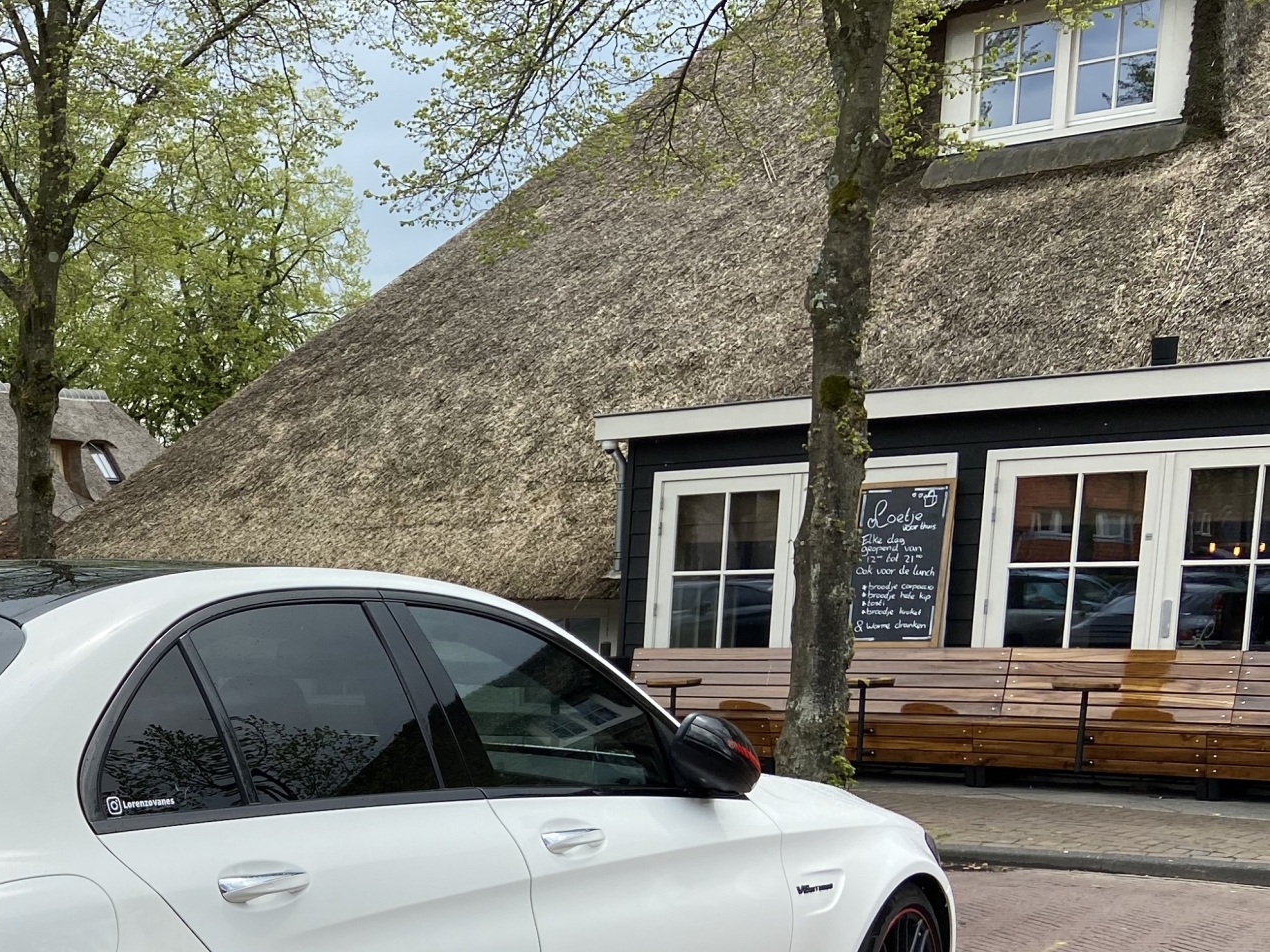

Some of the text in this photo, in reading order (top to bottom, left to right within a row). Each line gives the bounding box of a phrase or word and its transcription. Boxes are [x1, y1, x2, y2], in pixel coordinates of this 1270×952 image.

[867, 499, 923, 529] Loetje
[920, 522, 937, 530] thuis
[861, 533, 906, 546] Elke dag
[886, 552, 899, 563] tot
[856, 564, 873, 575] Ook
[899, 564, 910, 575] de
[912, 564, 935, 577] lunch
[868, 581, 898, 592] broodje
[867, 590, 896, 602] broodje
[919, 591, 931, 603] kip
[867, 599, 885, 607] tosti
[866, 606, 894, 617] broodje
[854, 620, 863, 632] &
[122, 798, 175, 809] Lorenzovanes
